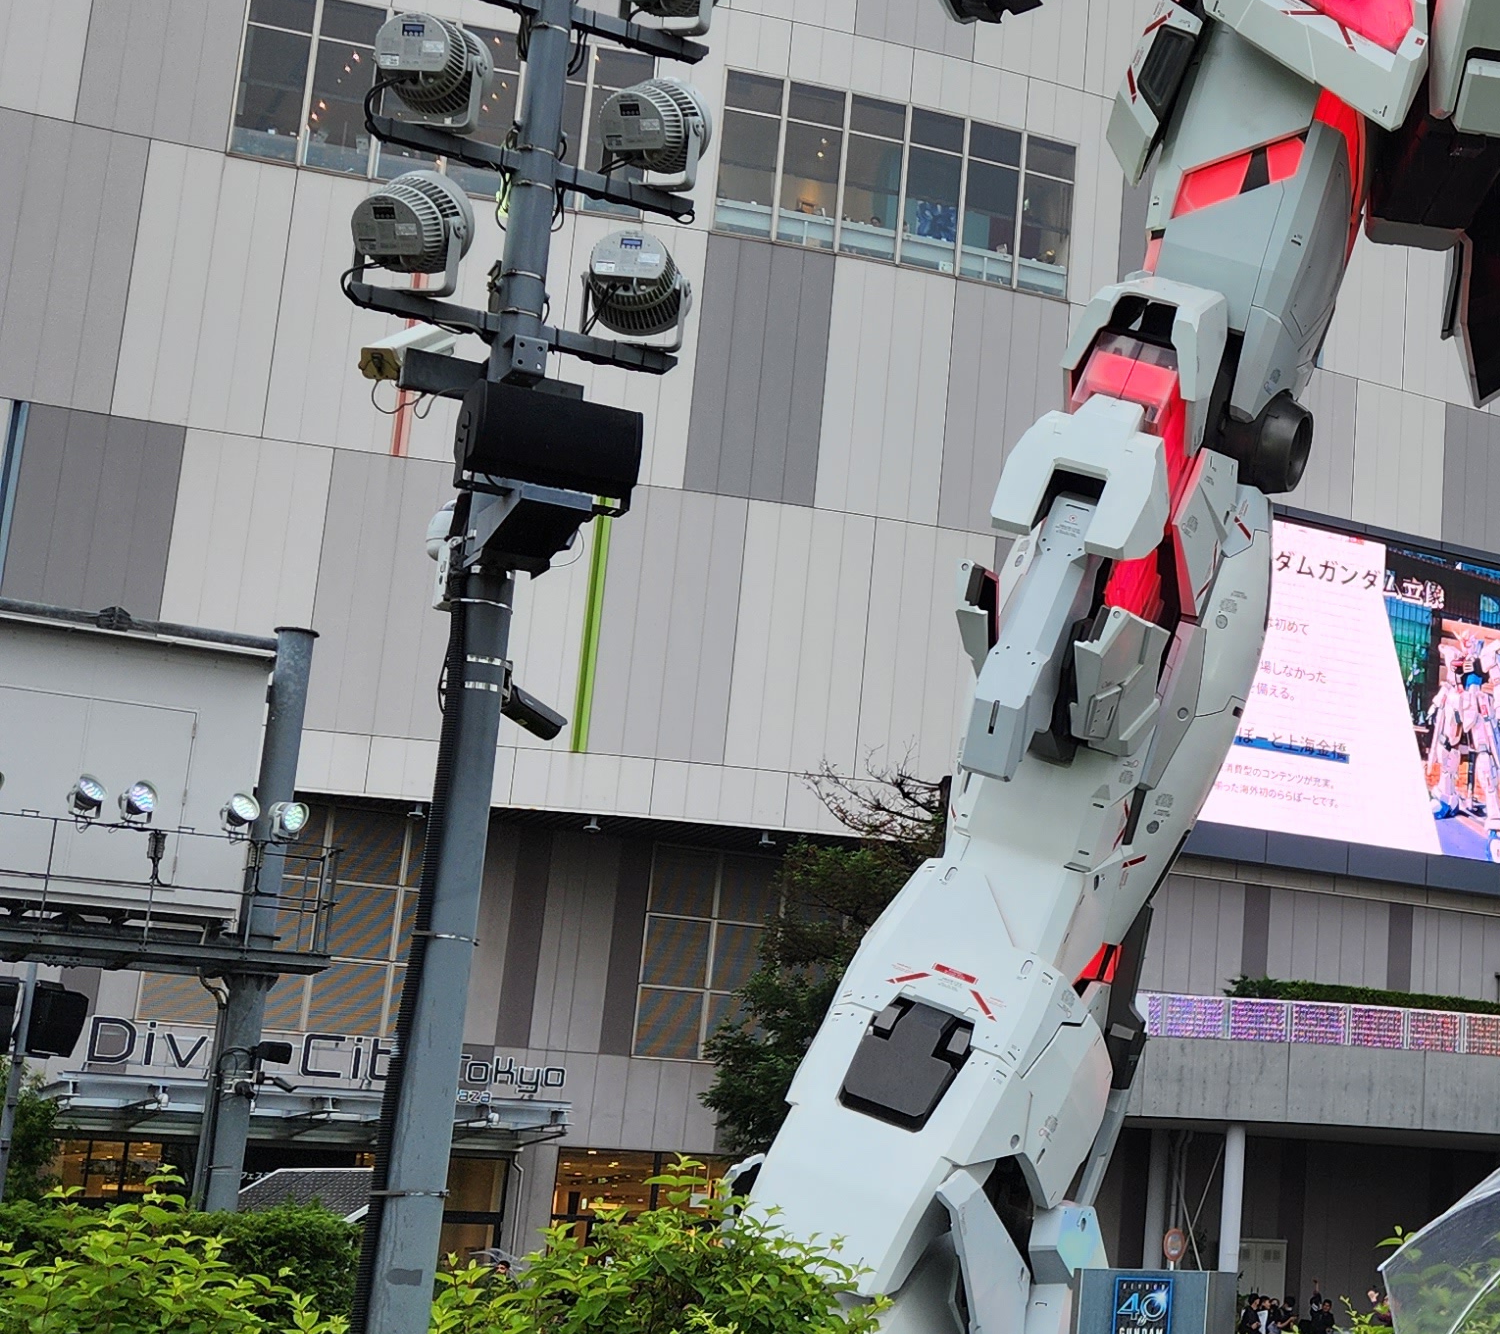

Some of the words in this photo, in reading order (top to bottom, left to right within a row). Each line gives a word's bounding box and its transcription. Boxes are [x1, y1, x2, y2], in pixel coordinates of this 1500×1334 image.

[1274, 550, 1446, 610] ダムガンダム立像
